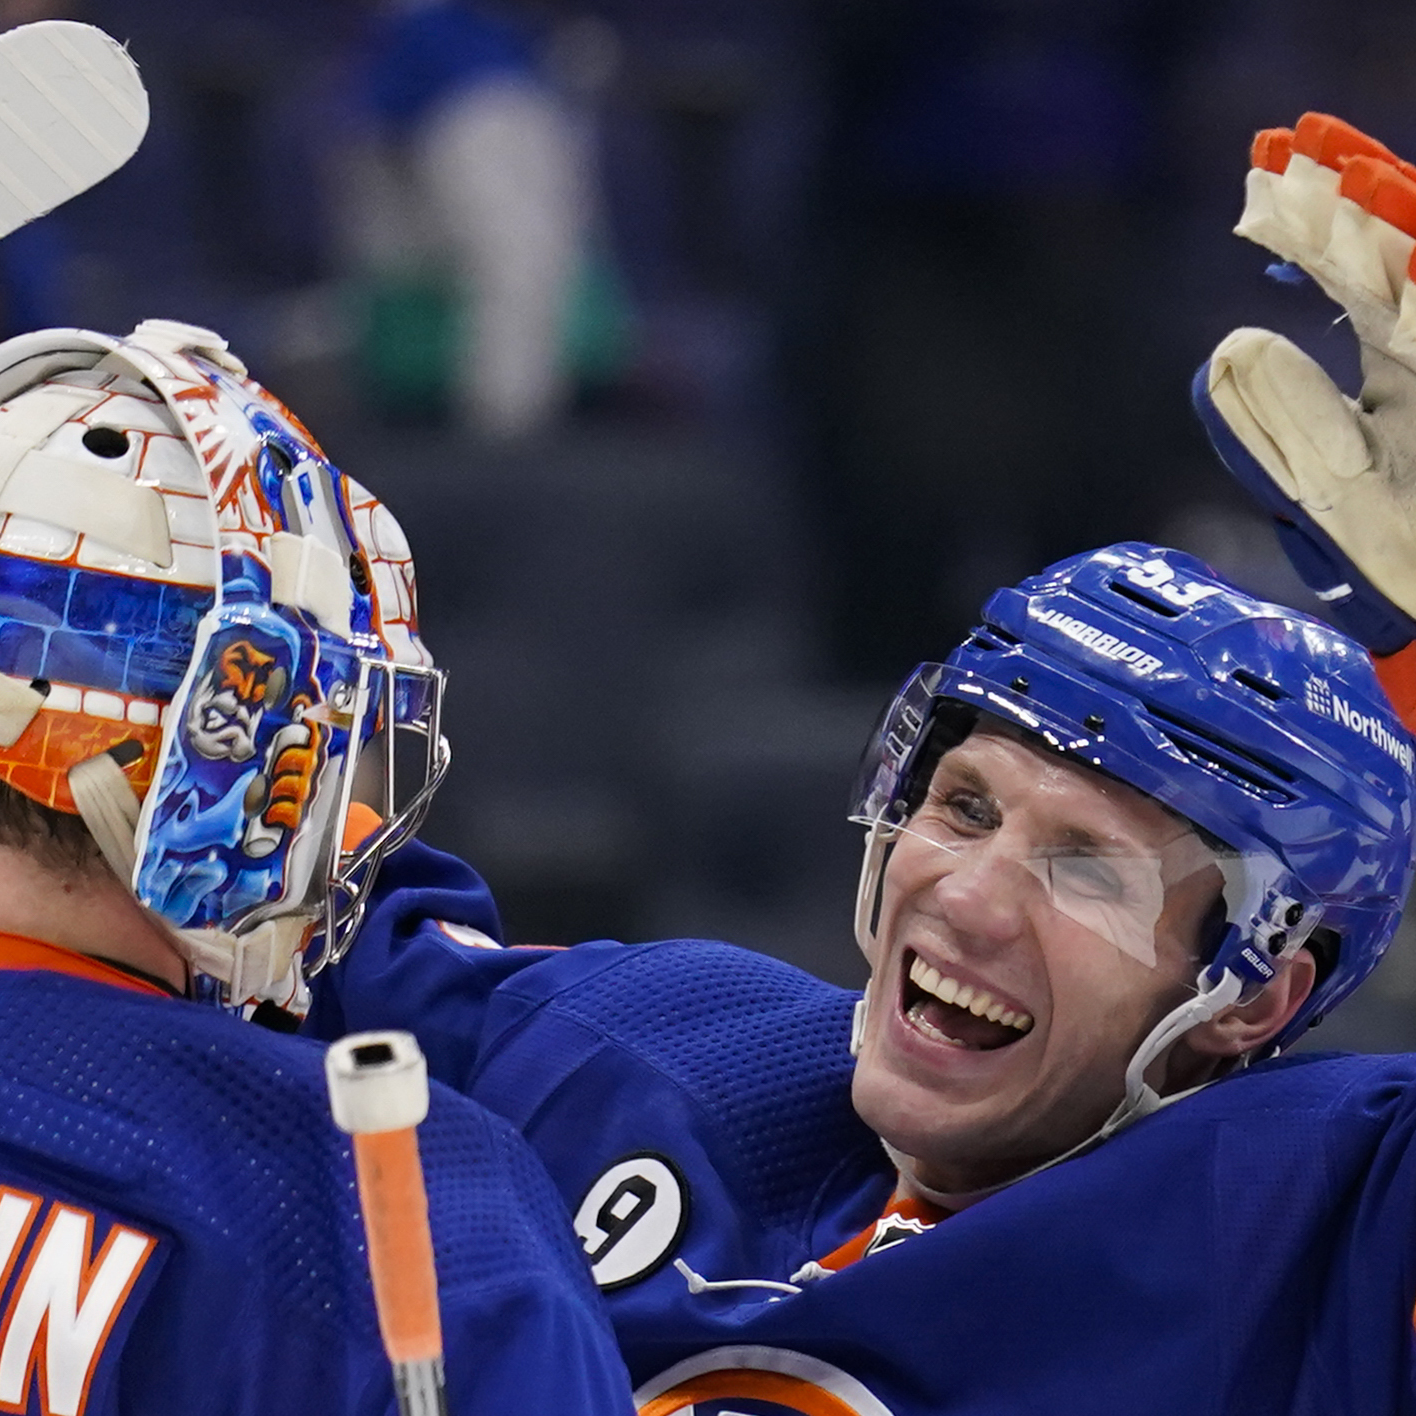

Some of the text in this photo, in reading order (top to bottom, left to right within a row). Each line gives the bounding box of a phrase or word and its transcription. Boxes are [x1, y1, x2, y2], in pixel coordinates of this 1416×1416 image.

[1038, 609, 1164, 676] WARRIOR
[1331, 694, 1415, 774] Northwell
[576, 1174, 658, 1266] 9
